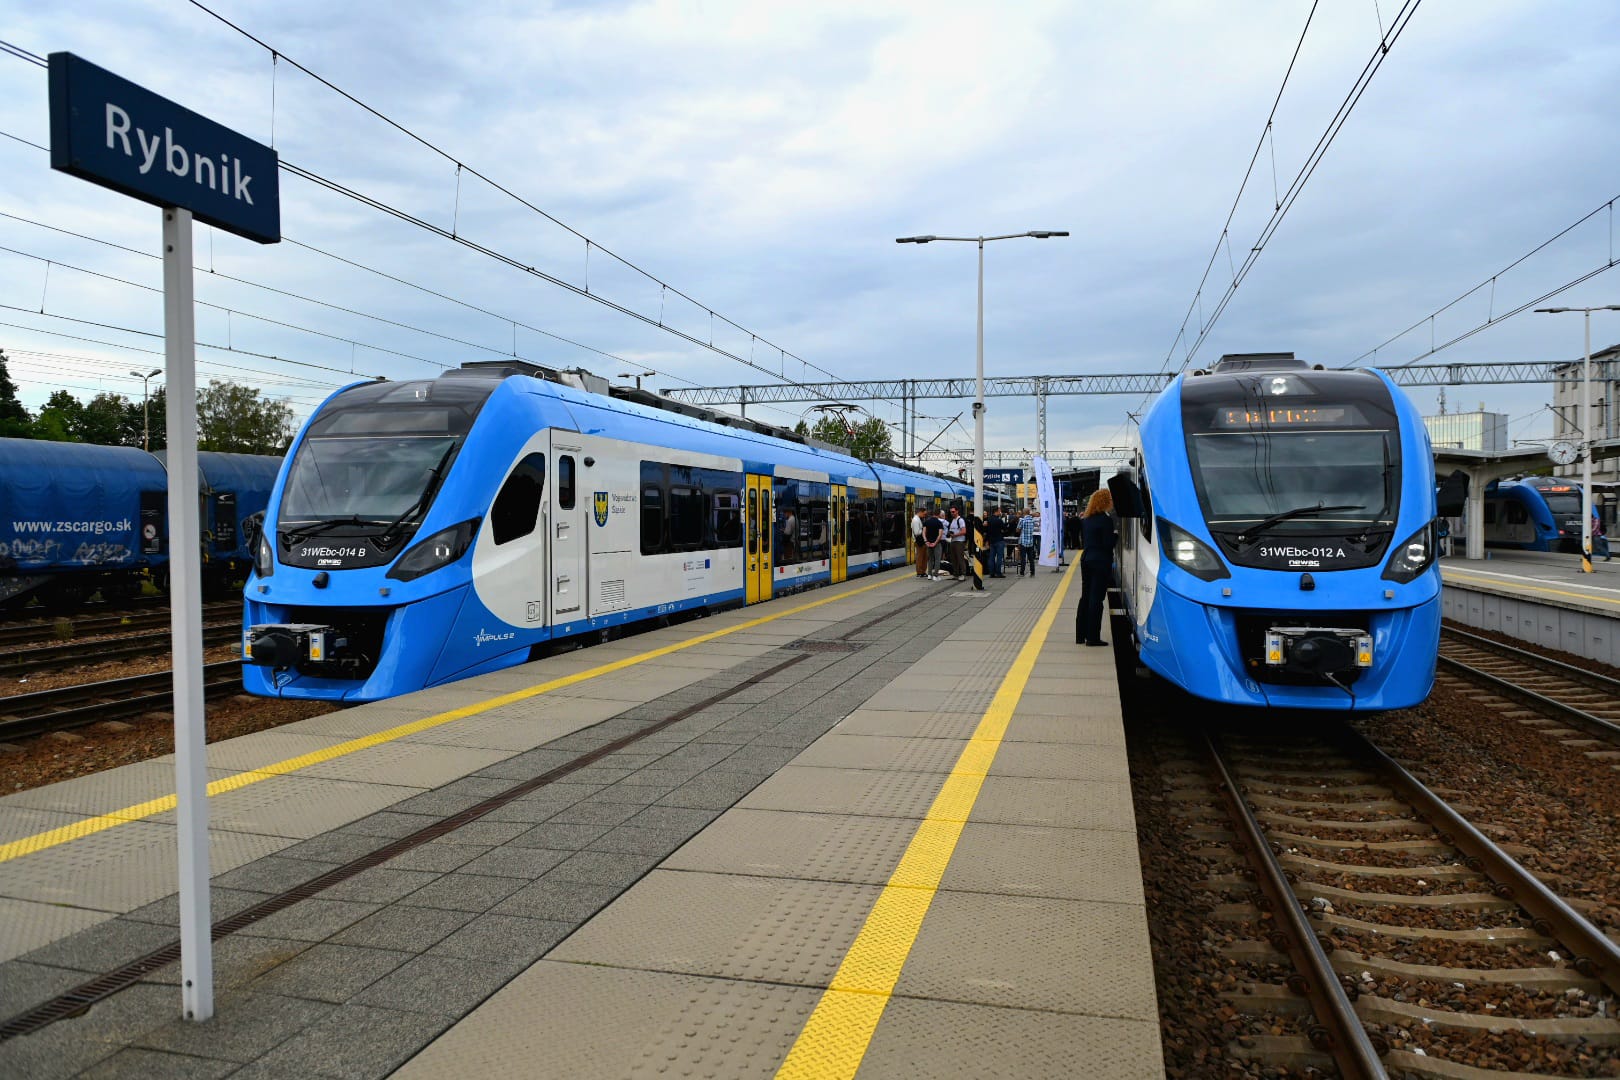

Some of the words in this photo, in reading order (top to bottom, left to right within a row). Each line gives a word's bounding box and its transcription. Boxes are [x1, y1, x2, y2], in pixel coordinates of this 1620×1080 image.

[106, 103, 254, 206] Rybnik
[13, 517, 132, 534] www.zscargo.sk
[301, 547, 356, 557] 31WEbc-014
[358, 547, 366, 557] B
[1260, 547, 1333, 558] 31WEbc-012
[1336, 548, 1346, 558] A
